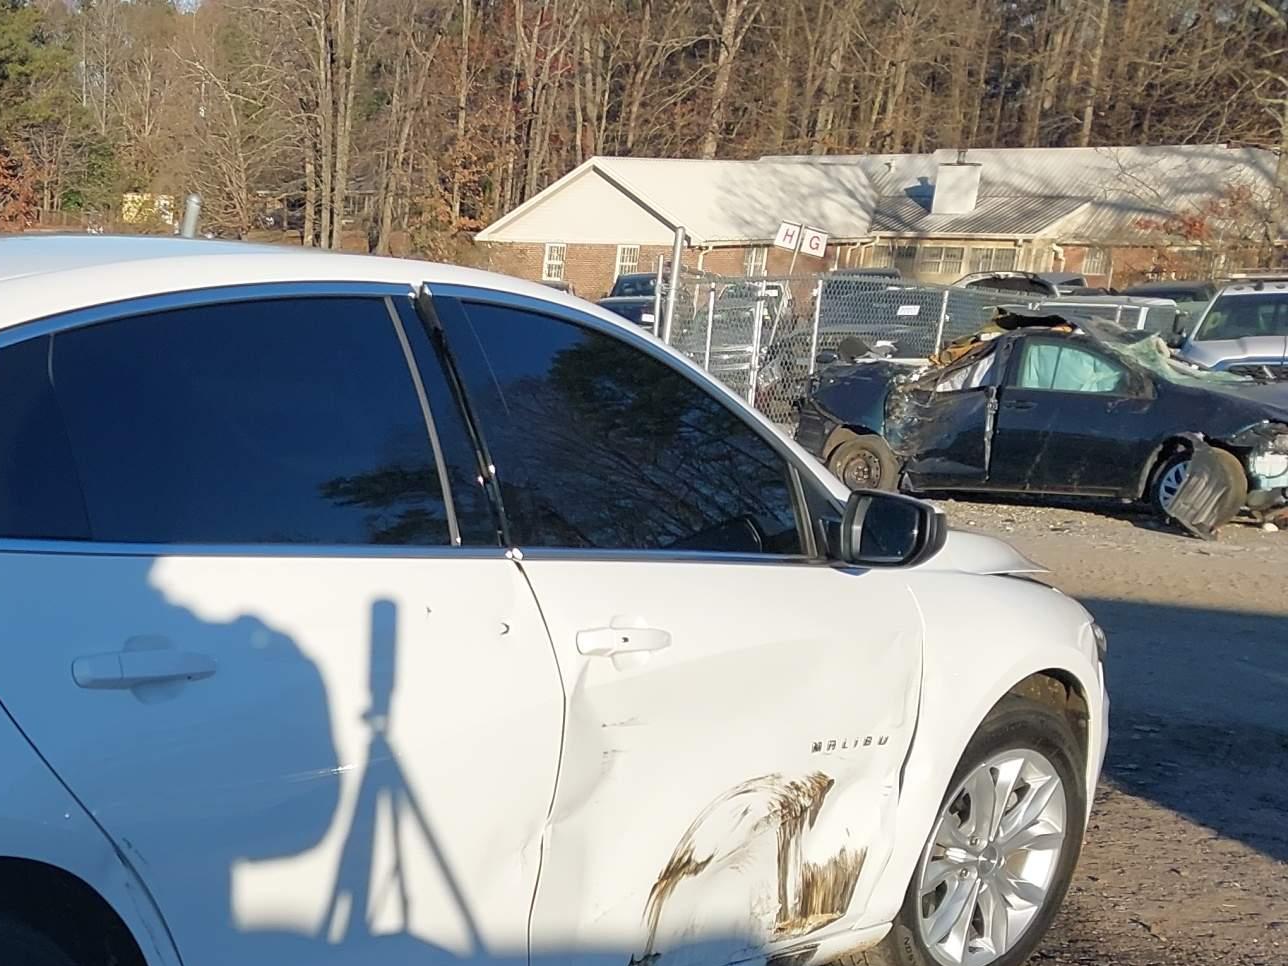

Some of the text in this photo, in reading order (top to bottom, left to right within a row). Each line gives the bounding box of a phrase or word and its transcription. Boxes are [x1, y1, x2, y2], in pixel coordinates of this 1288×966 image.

[782, 228, 796, 244] H
[809, 235, 821, 250] G
[811, 735, 889, 753] MALIBU
